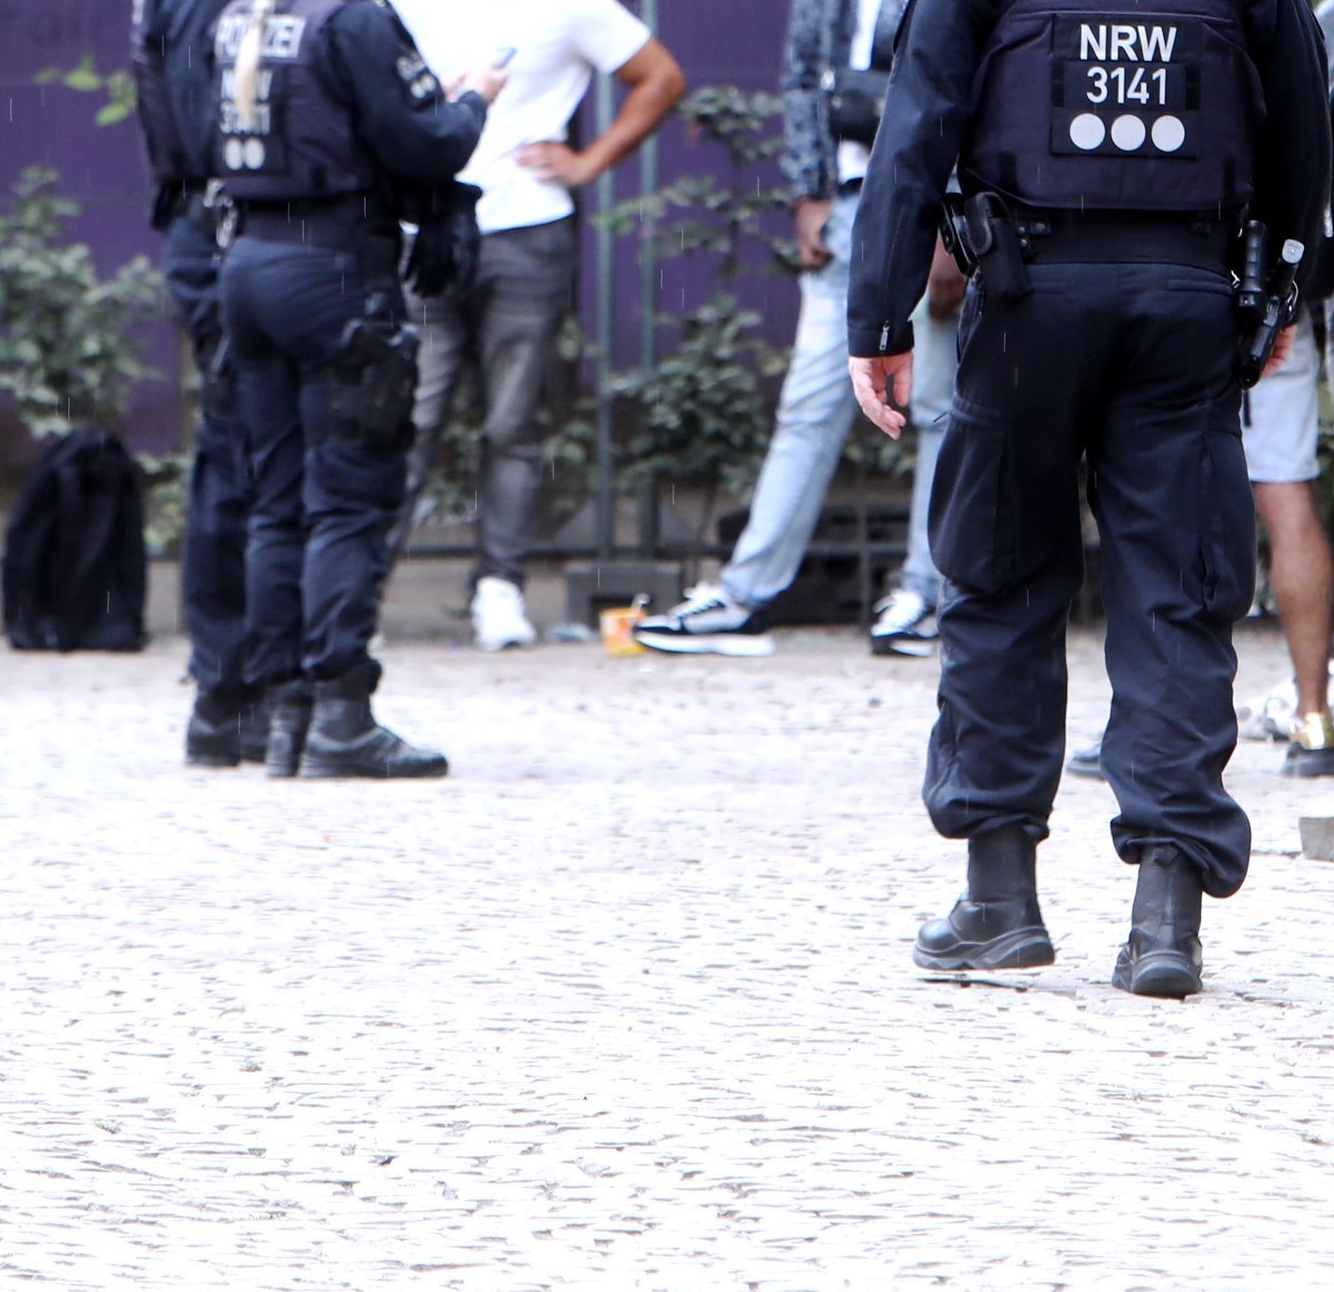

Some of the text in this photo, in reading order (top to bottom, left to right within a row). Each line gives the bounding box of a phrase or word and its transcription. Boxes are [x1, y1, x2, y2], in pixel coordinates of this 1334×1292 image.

[214, 13, 307, 59] POZEI
[1079, 24, 1177, 62] NRW
[220, 68, 274, 102] NW
[1086, 66, 1167, 105] 3141
